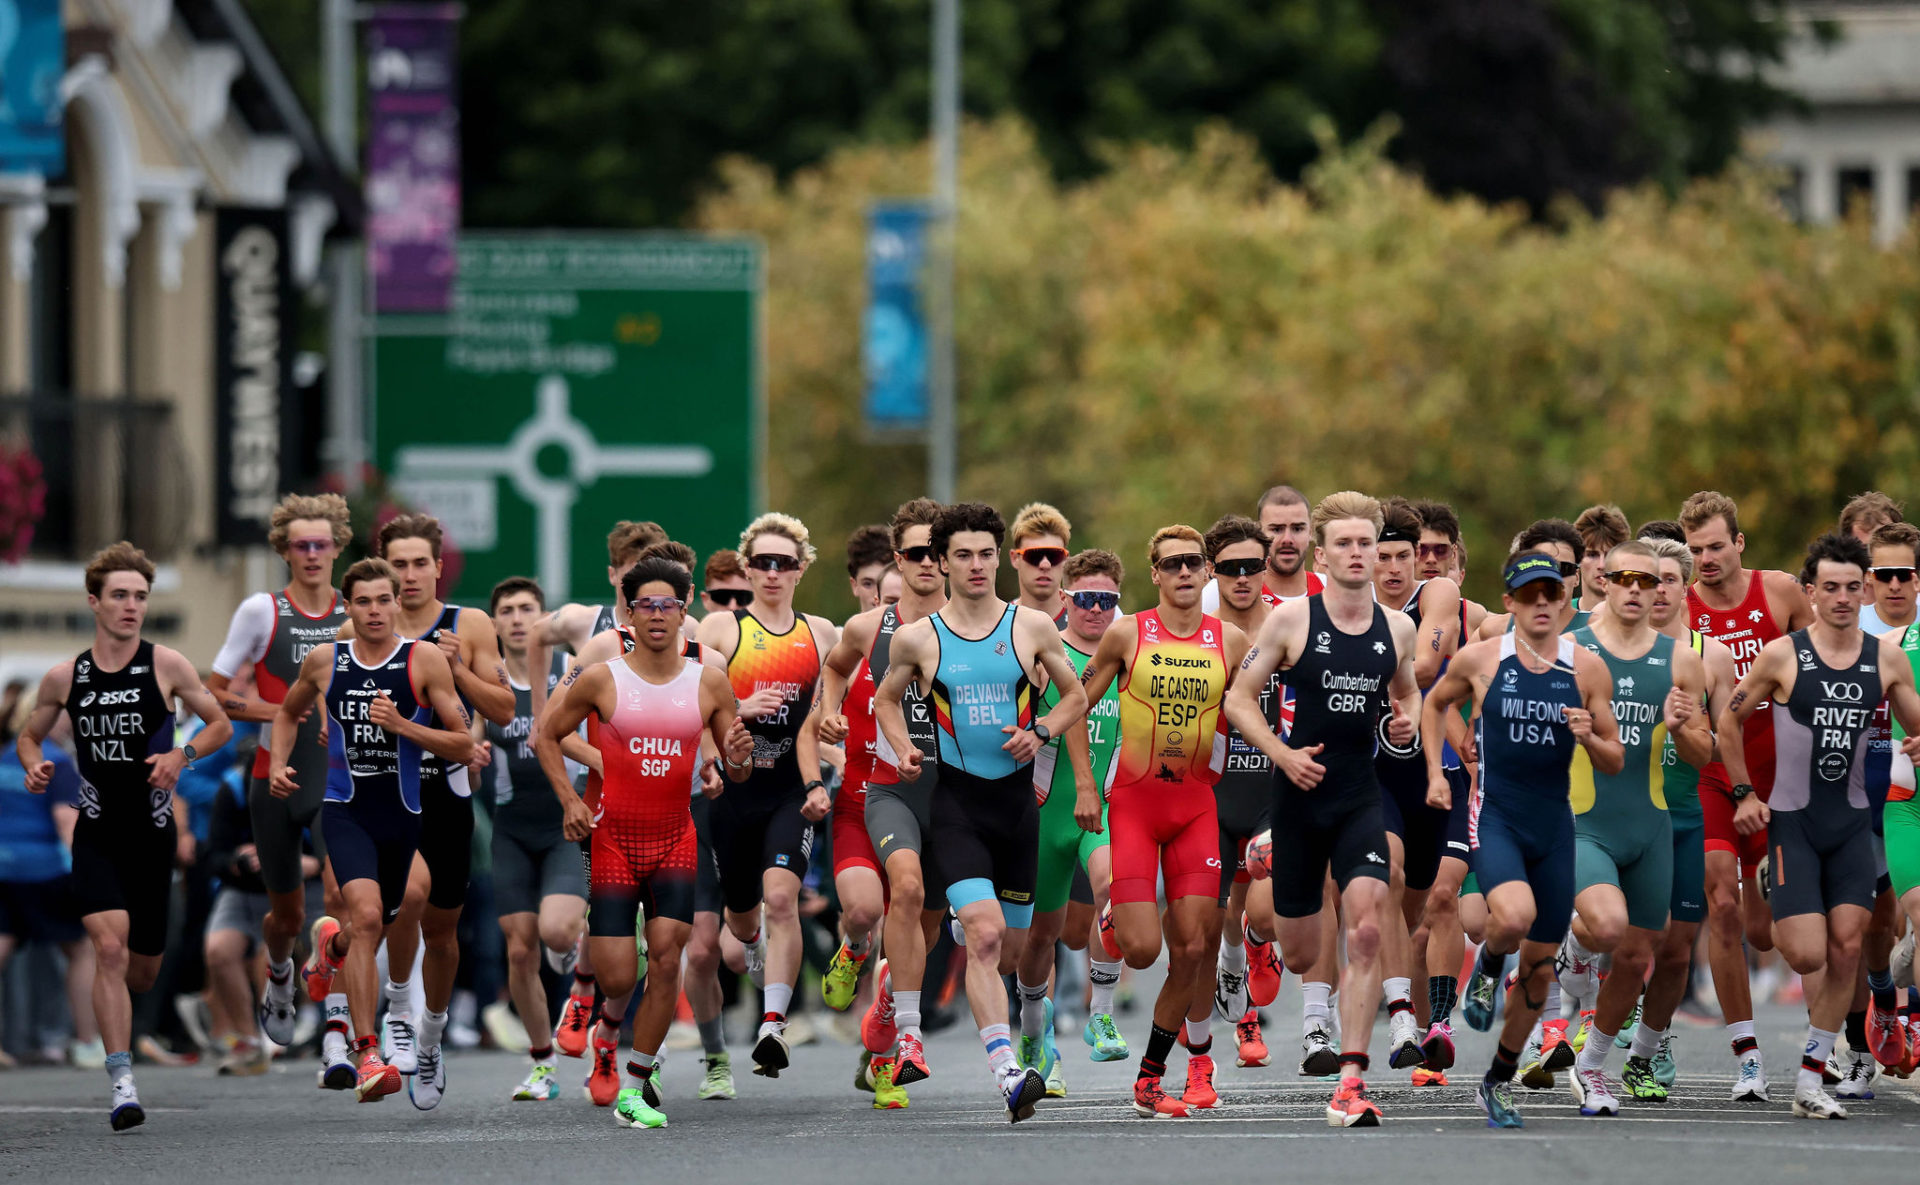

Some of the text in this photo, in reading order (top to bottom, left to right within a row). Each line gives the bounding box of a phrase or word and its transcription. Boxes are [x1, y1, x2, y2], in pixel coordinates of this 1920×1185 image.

[222, 226, 280, 519] QUAYWEST
[1165, 657, 1211, 669] SUZUKI
[1151, 675, 1209, 703] DE CASTRO
[1321, 669, 1381, 692] Cumberland
[955, 684, 1010, 705] DELVAUX
[1327, 693, 1367, 714] GBR
[968, 705, 1002, 726] BEL
[1158, 703, 1198, 728] ESP
[1501, 698, 1568, 725] WILFONG
[1812, 707, 1871, 729] RIVET
[79, 713, 146, 738] OLIVER
[354, 725, 387, 744] FRA
[1086, 719, 1106, 744] RL
[1508, 723, 1557, 747] USA
[1618, 724, 1641, 746] US
[628, 737, 682, 757] CHUA
[1820, 729, 1852, 750] FRA
[91, 741, 134, 763] NZL
[640, 758, 671, 777] SGP
